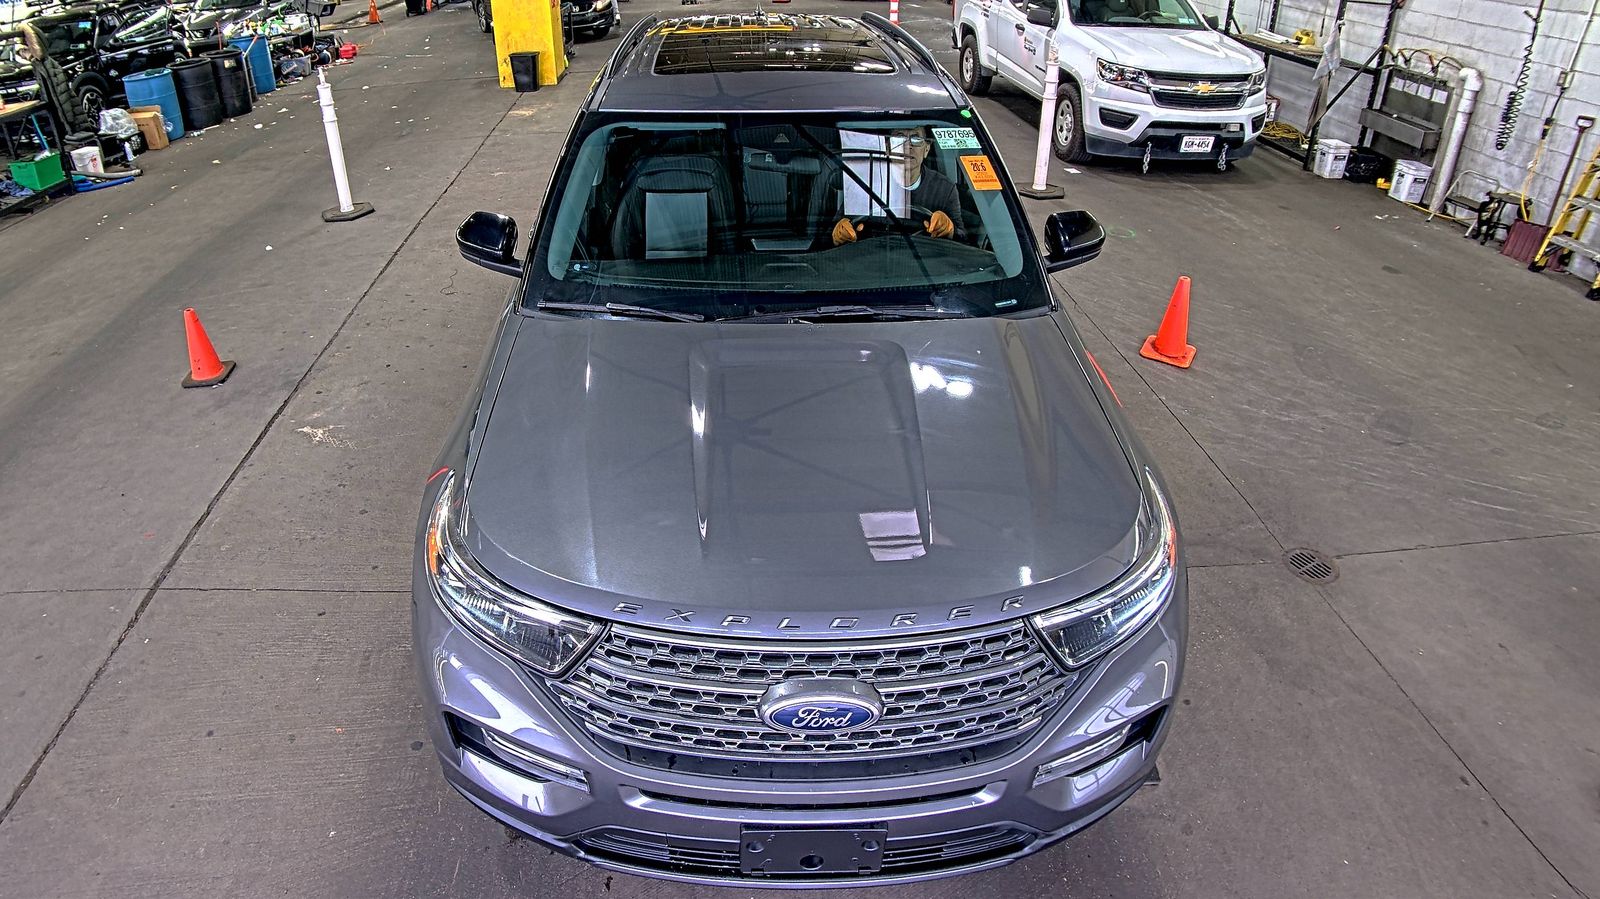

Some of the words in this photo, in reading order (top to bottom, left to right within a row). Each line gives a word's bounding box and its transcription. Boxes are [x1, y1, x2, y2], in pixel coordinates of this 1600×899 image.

[935, 130, 975, 138] 9787695
[612, 594, 1025, 630] EXPLORER
[791, 706, 853, 728] Ford
